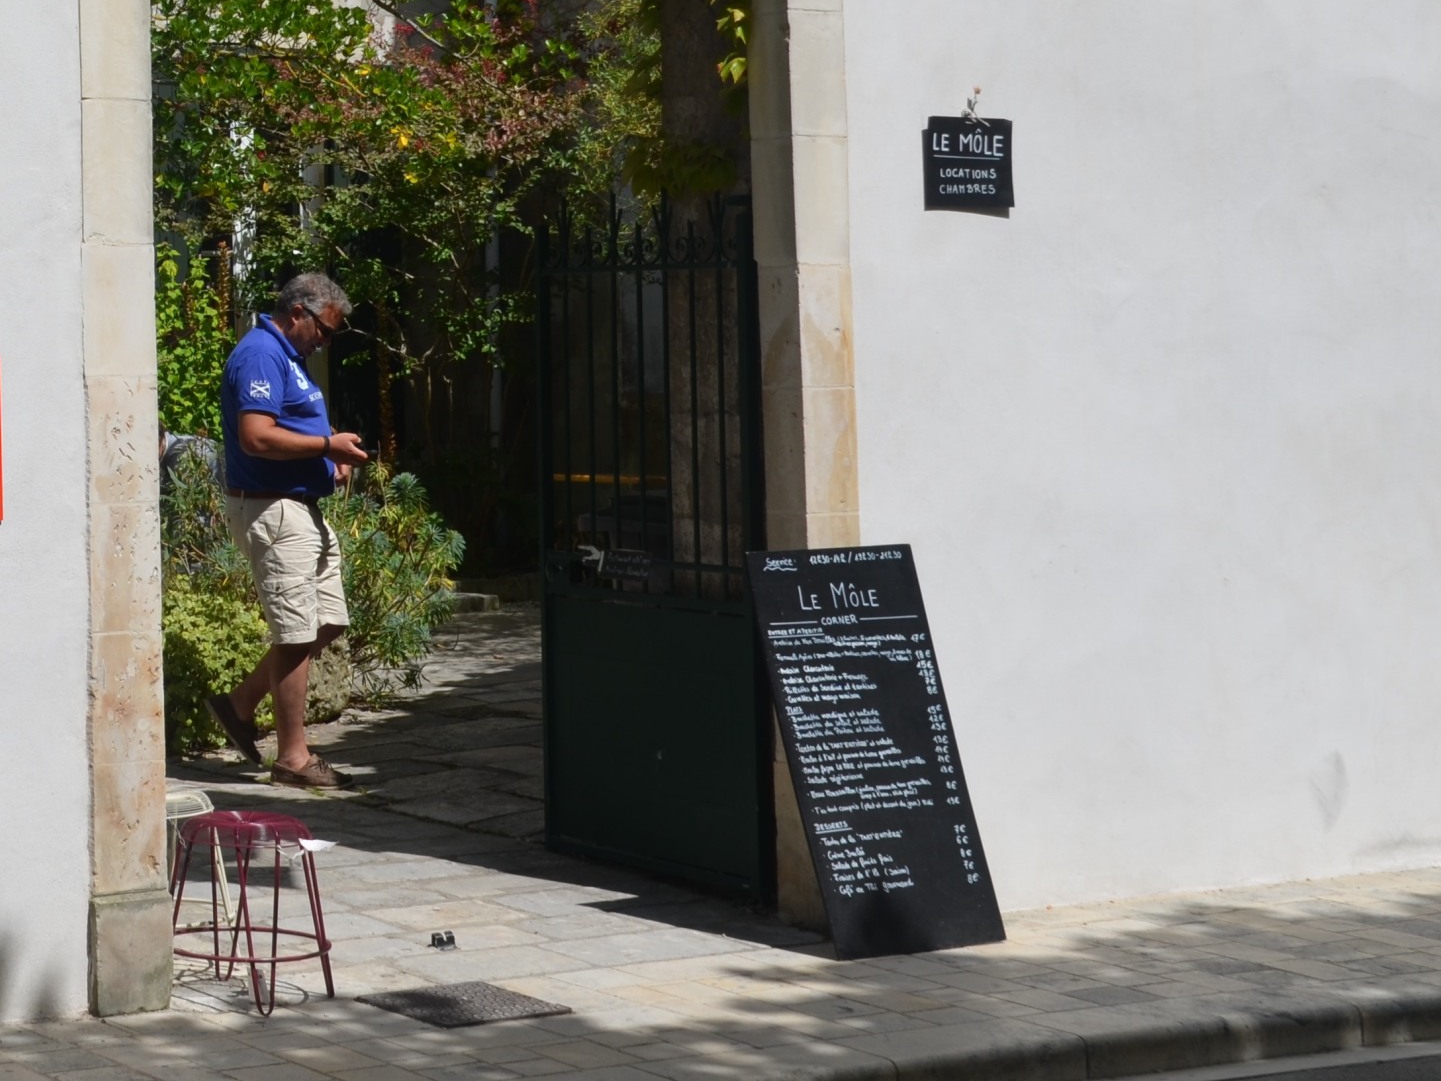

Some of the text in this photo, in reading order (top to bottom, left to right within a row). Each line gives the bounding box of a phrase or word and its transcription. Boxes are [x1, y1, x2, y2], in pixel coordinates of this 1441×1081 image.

[933, 128, 1003, 156] LE MÔLE
[940, 168, 996, 179] LOCATIONS
[939, 184, 995, 194] CHAMBRES
[821, 614, 858, 625] CORNER
